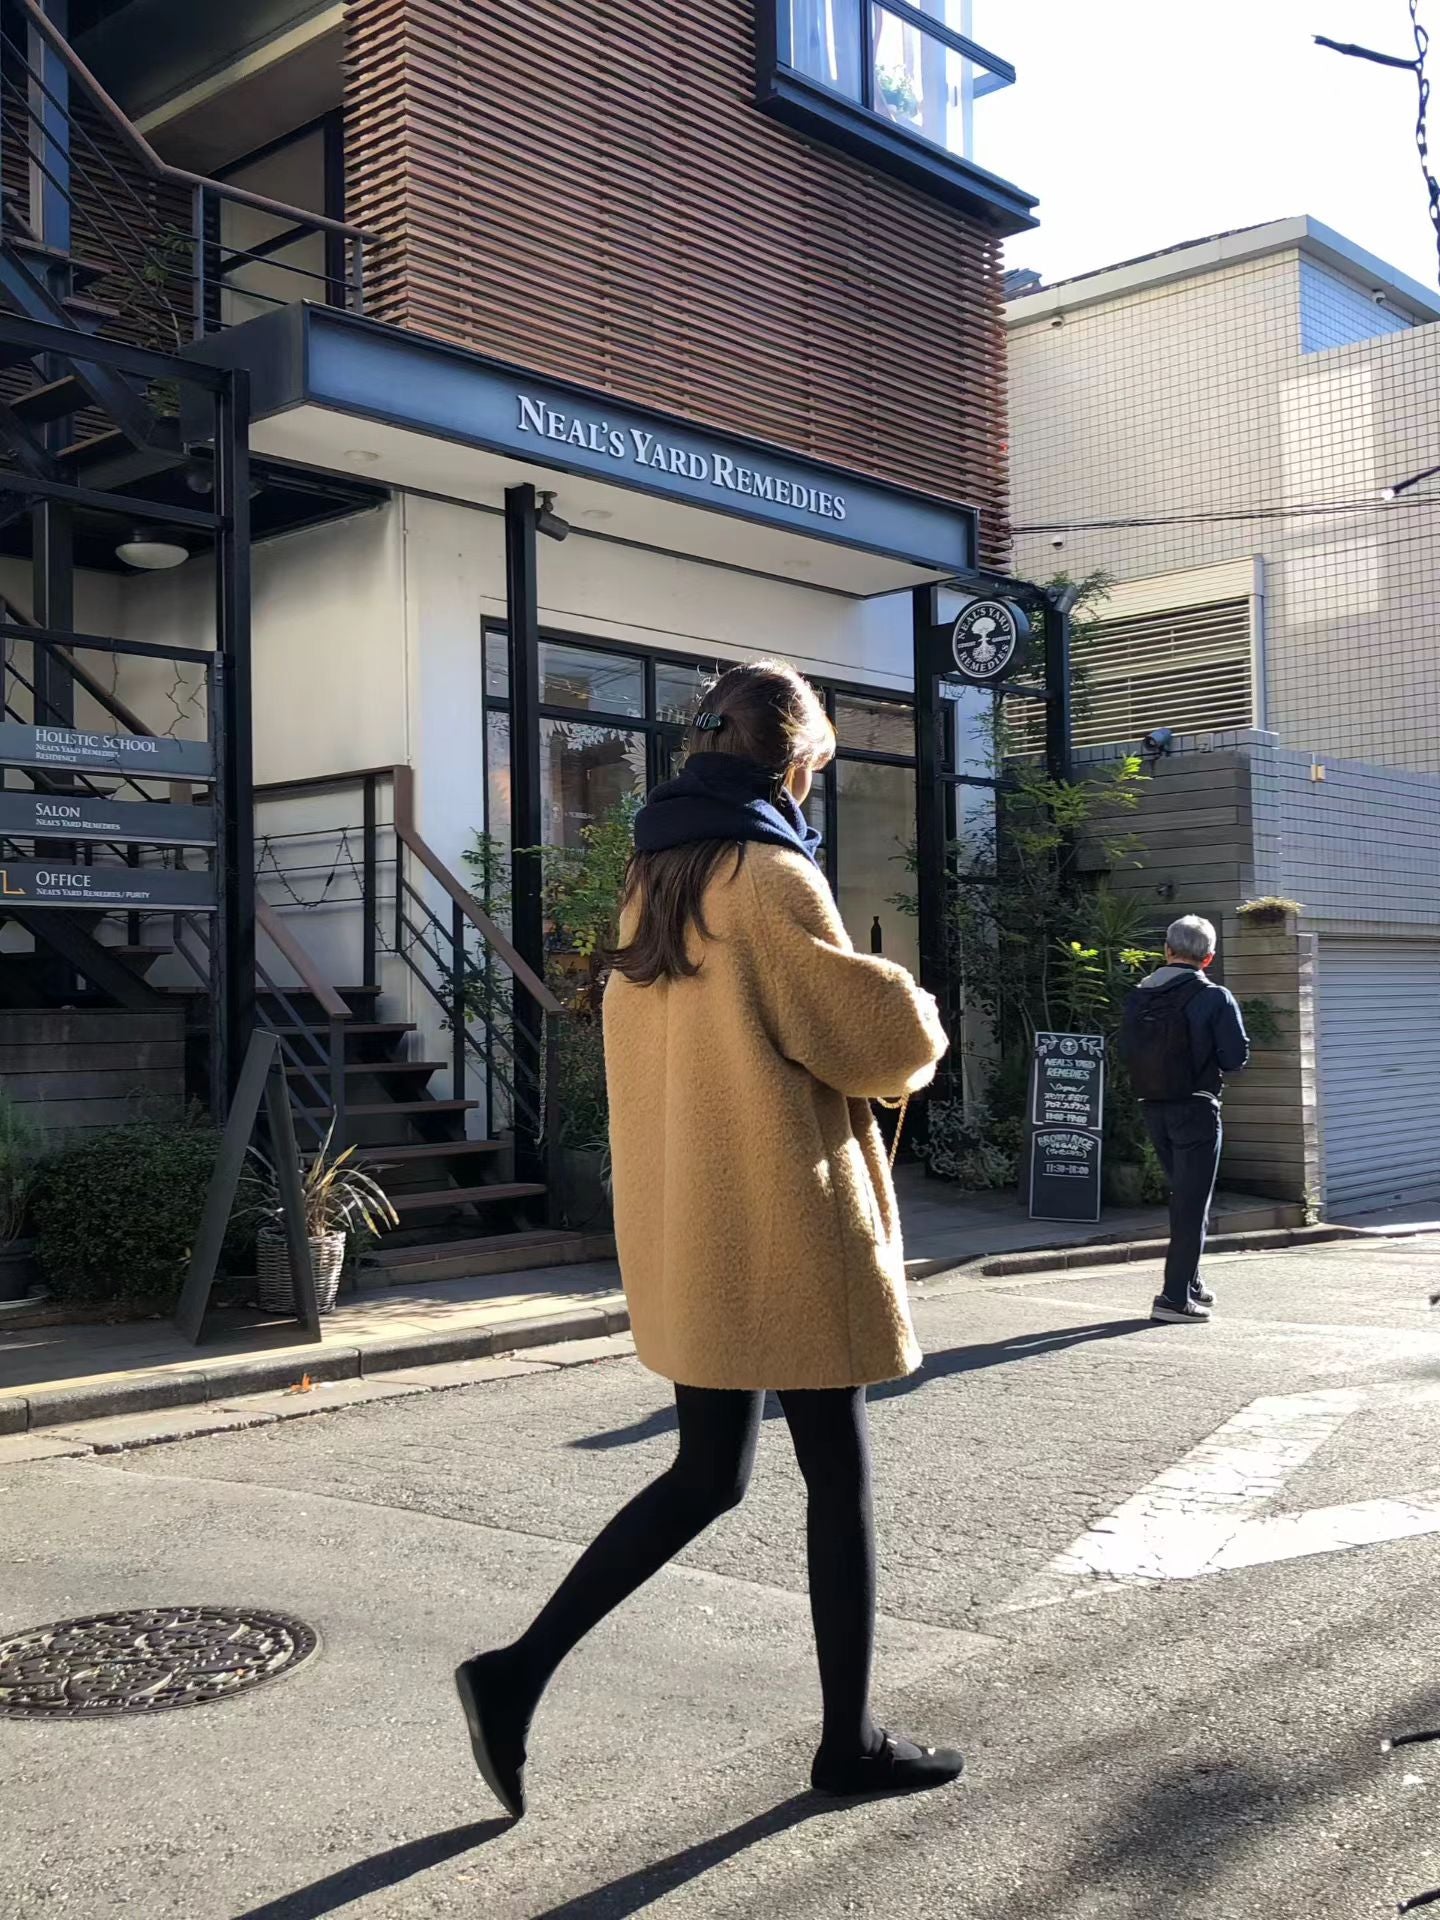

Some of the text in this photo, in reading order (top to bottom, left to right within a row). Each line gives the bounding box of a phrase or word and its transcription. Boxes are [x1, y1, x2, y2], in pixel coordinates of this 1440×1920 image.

[517, 394, 847, 520] NEAL'S YARD REMEDIES
[988, 607, 1011, 632] YARD
[959, 643, 1009, 672] REMEDIES
[35, 728, 159, 753] HOLISTIC SCHOOL
[35, 751, 77, 762] RESIDENCE
[35, 802, 80, 818] SALON
[61, 819, 82, 828] YARD
[82, 820, 121, 830] REMEDIES
[35, 871, 92, 887] OFFICE
[61, 888, 82, 897] YARD
[1071, 1134, 1095, 1150] RICE
